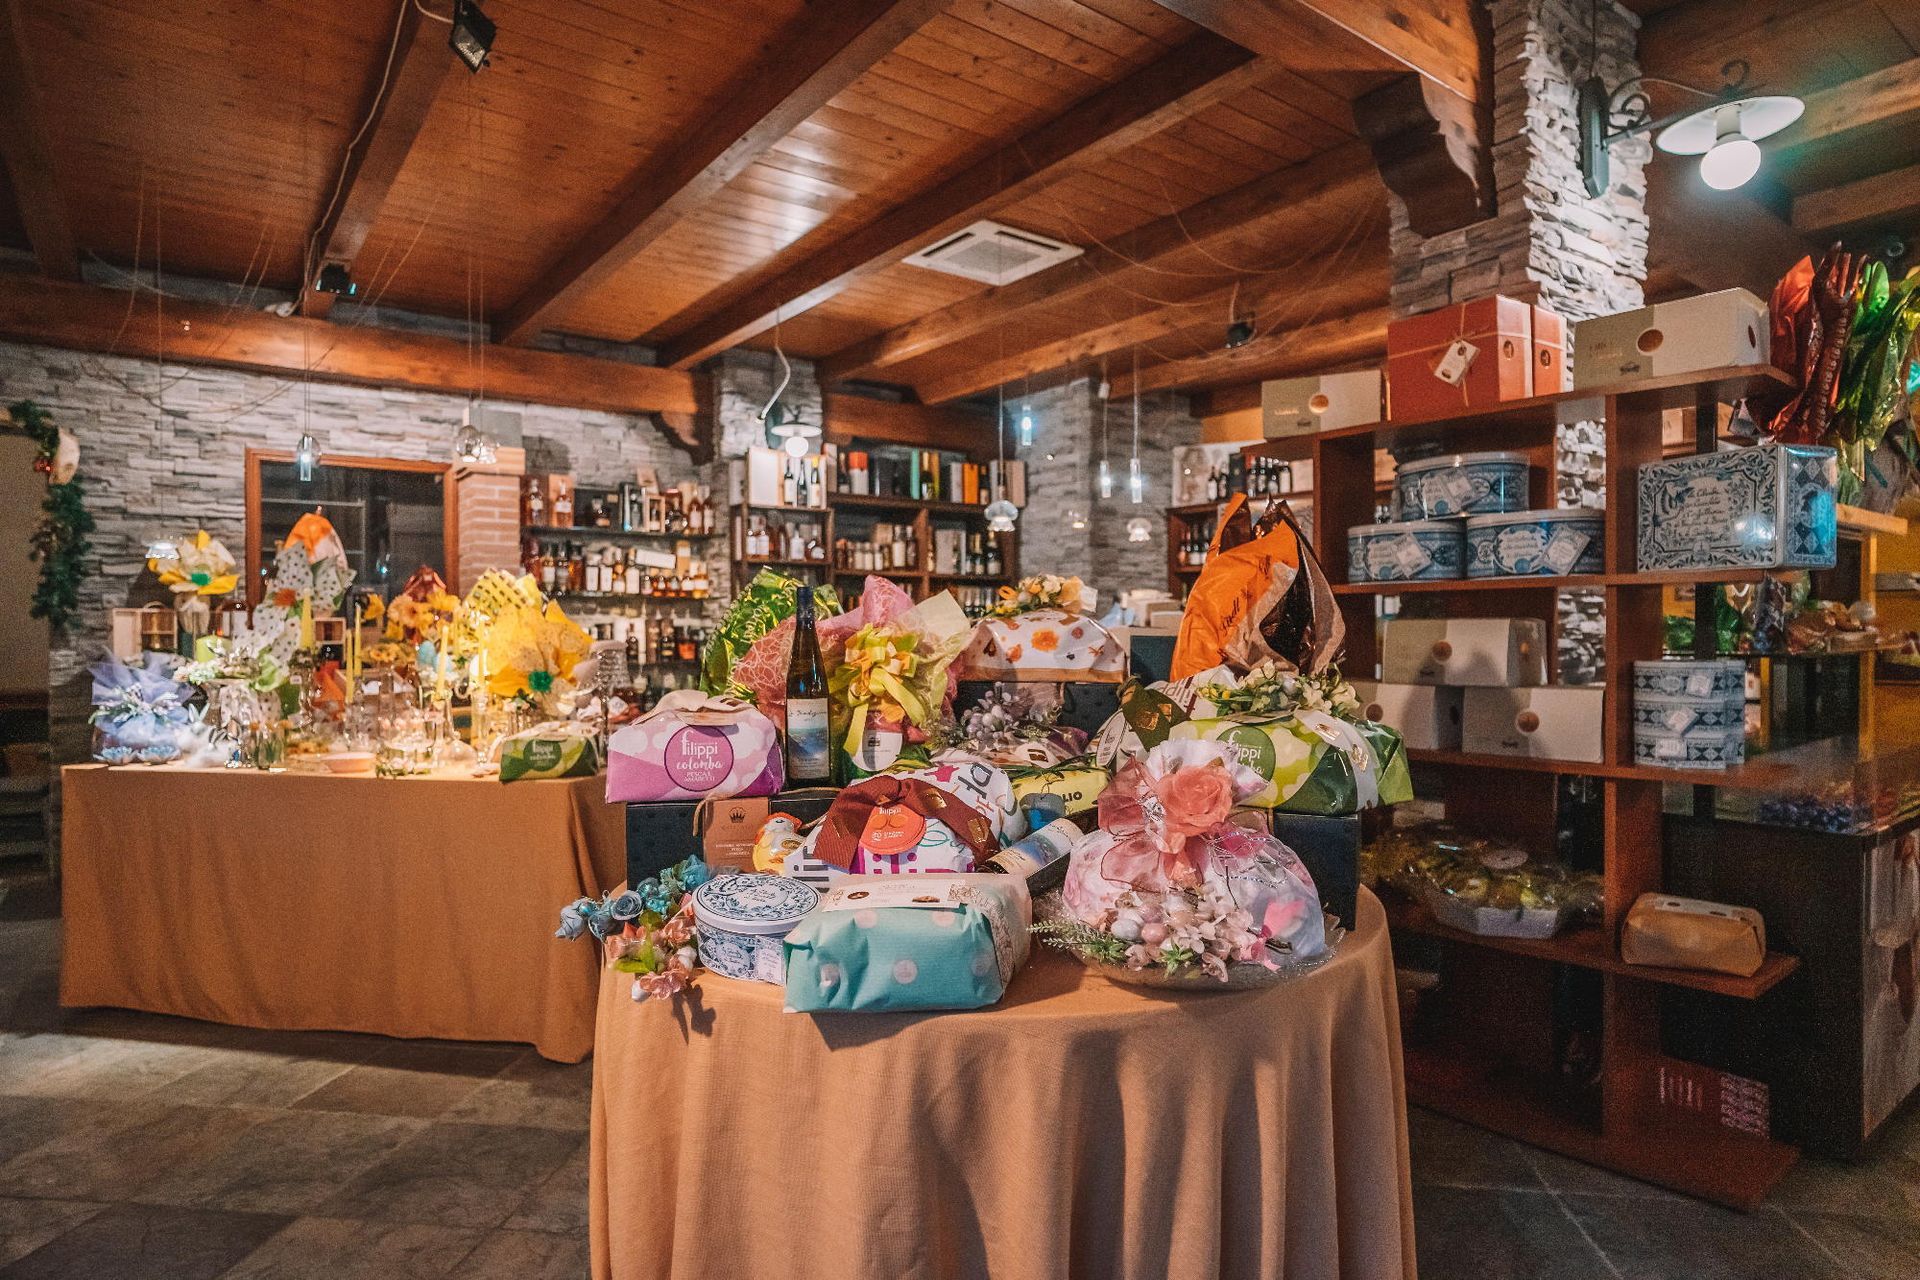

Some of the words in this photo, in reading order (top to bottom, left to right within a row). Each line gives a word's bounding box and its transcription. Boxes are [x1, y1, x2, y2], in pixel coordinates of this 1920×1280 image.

[681, 730, 718, 759] filippi
[1227, 730, 1262, 762] fippi
[676, 756, 723, 770] colomba
